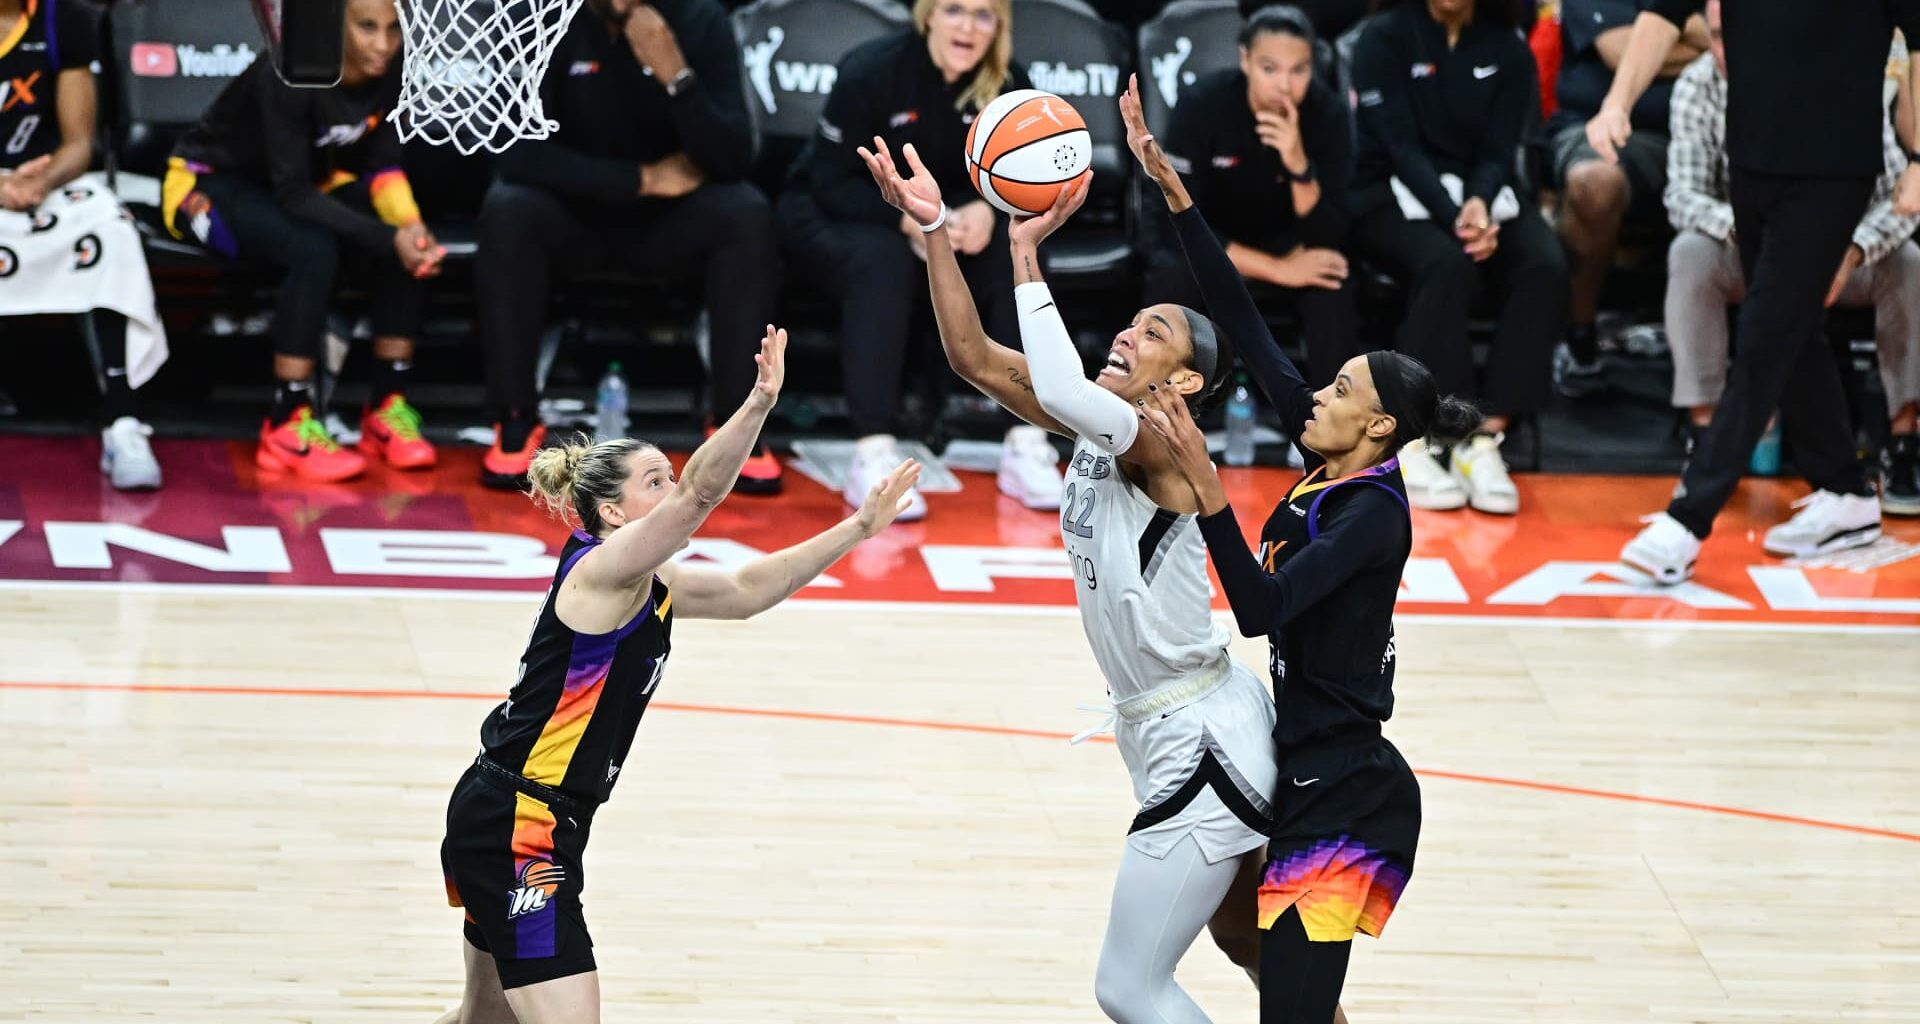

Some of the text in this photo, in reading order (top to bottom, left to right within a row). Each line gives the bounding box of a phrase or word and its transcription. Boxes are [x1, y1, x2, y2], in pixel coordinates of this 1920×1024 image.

[177, 43, 256, 77] YouTub
[775, 60, 838, 94] WN
[1085, 63, 1120, 96] TV
[1063, 482, 1096, 539] 22
[0, 519, 845, 590] NBA
